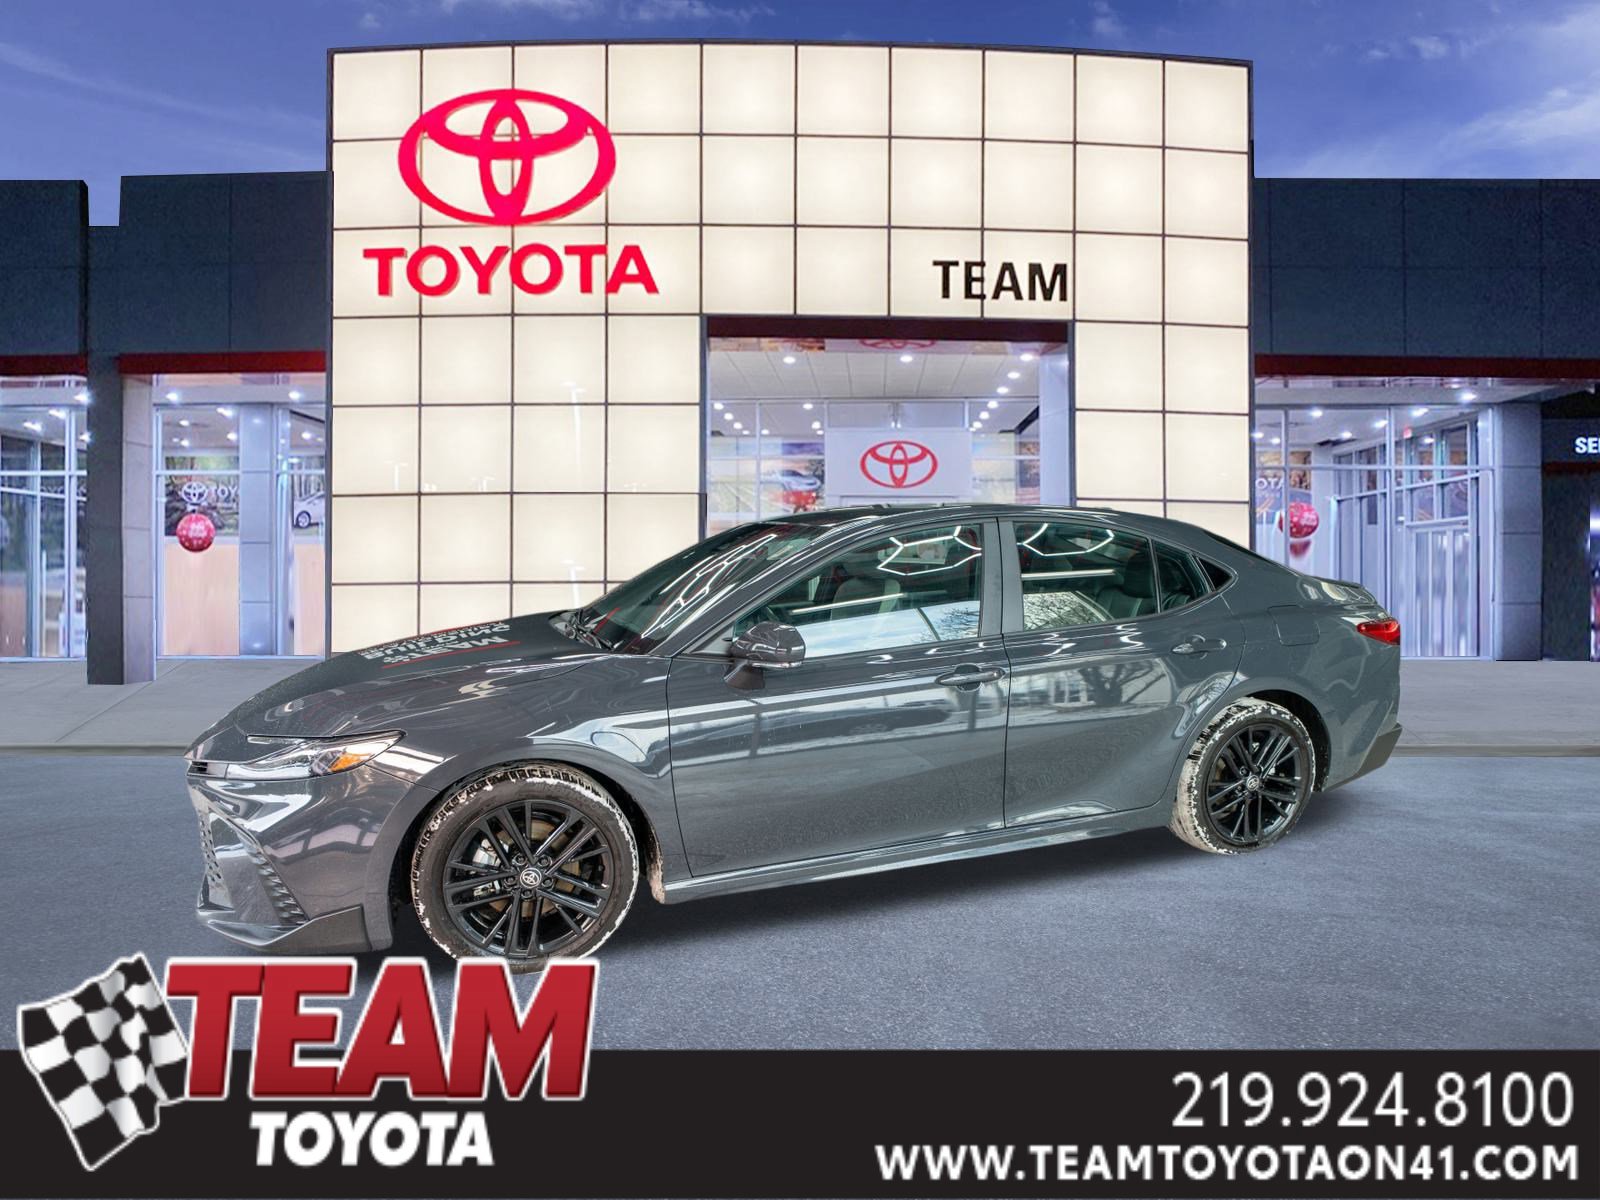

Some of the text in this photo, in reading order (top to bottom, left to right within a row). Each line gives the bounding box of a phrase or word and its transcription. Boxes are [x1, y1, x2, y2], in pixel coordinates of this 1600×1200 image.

[363, 243, 660, 297] TOYOTA
[932, 259, 1068, 302] TEAM
[1575, 436, 1600, 454] SE
